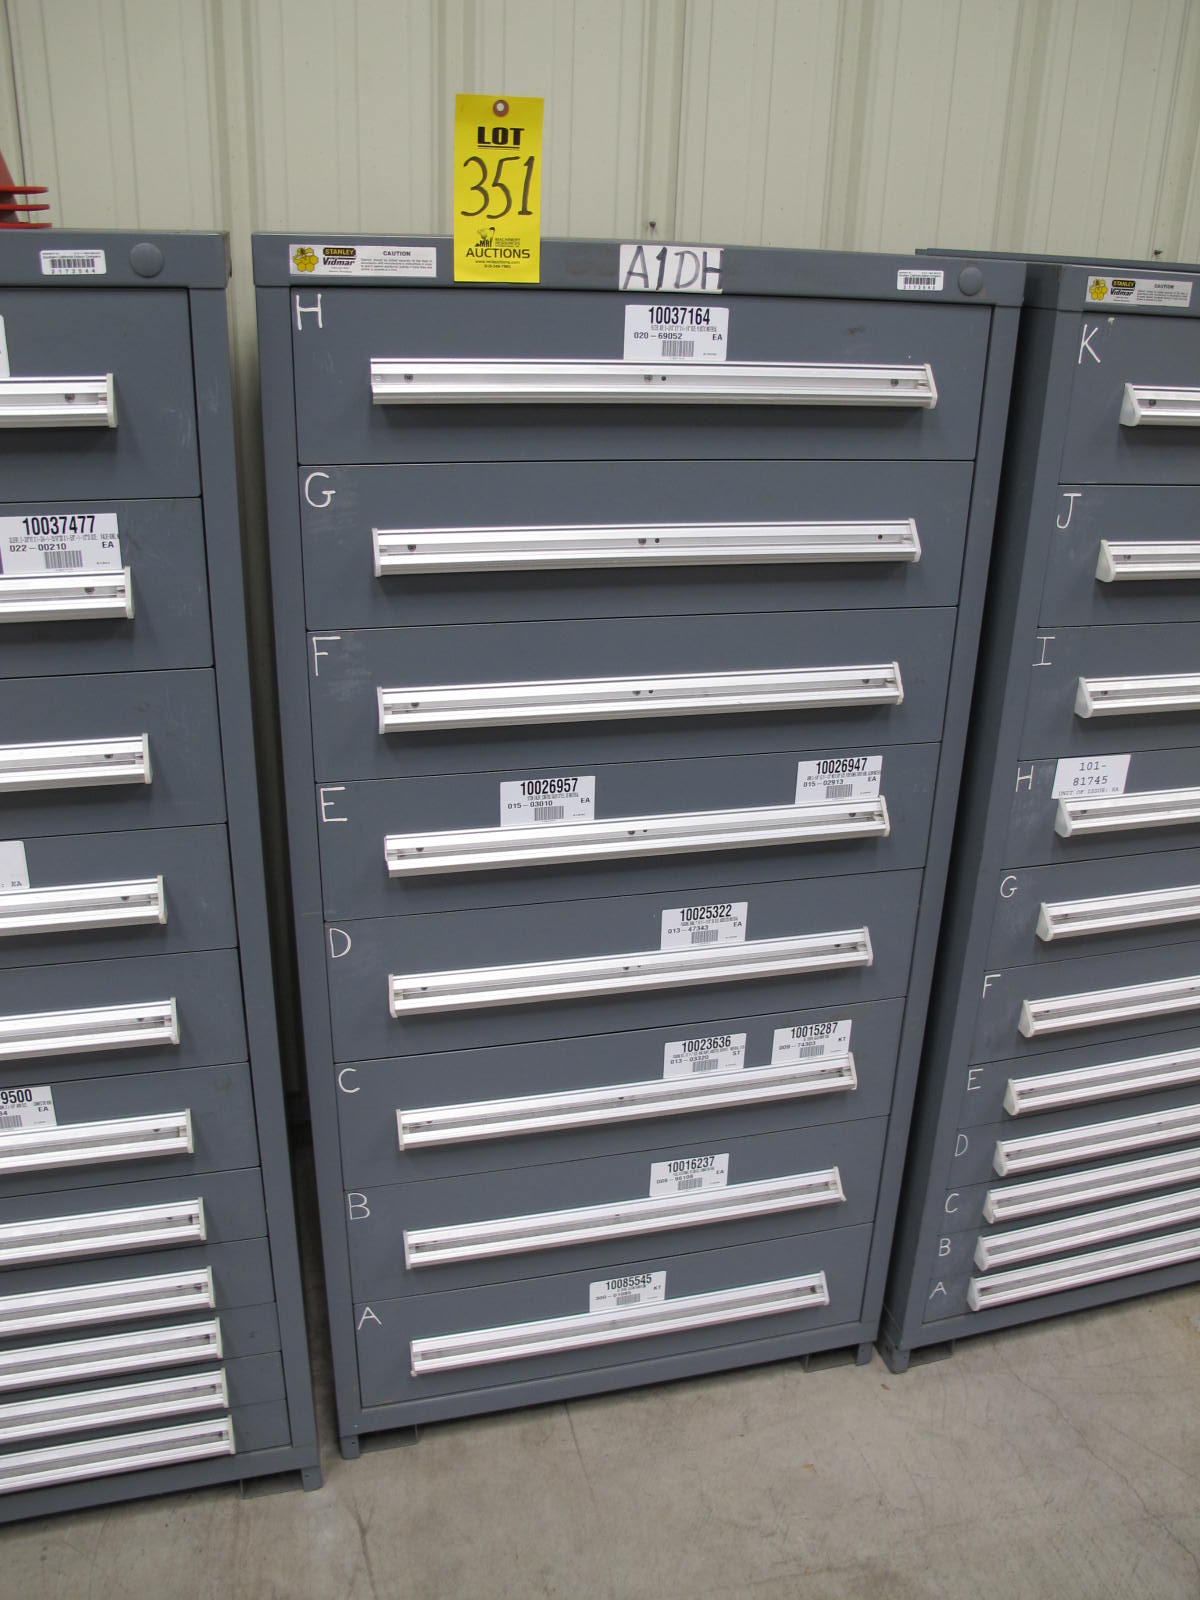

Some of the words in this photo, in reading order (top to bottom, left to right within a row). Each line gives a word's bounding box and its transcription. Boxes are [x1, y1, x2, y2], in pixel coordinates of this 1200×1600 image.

[477, 126, 525, 145] LOT
[460, 155, 535, 219] 351
[323, 257, 355, 266] Vidmar
[324, 248, 355, 256] STANLEY
[466, 248, 530, 259] AUCTIONS
[623, 245, 724, 290] A1DH
[1110, 288, 1134, 297] Vidmar
[1112, 280, 1135, 288] STANLEY
[296, 293, 323, 331] H
[648, 306, 711, 325] 10037164
[1078, 323, 1101, 364] K
[304, 471, 336, 508] G
[1056, 492, 1082, 529] J
[22, 515, 95, 536] 10037477
[102, 541, 113, 549] EA
[312, 636, 342, 676] F
[1032, 636, 1056, 667] I
[815, 758, 868, 775] 10026947
[1079, 761, 1107, 772] 101-
[520, 778, 578, 796] 10026957
[1015, 765, 1034, 793] H
[1072, 775, 1108, 787] 81745
[320, 786, 348, 822] E
[1000, 875, 1018, 899] G
[680, 904, 732, 922] 10025322
[329, 928, 351, 958] D
[982, 973, 1002, 1000] F
[791, 1022, 838, 1039] 10015287
[682, 1036, 732, 1053] 10023636
[338, 1068, 360, 1093] C
[967, 1068, 984, 1091] E
[955, 1134, 969, 1157] D
[668, 1156, 715, 1173] 10016237
[348, 1192, 370, 1220] B
[944, 1193, 960, 1214] C
[938, 1238, 951, 1257] B
[606, 1273, 652, 1291] 10085545
[928, 1281, 947, 1300] A
[358, 1306, 382, 1330] A
